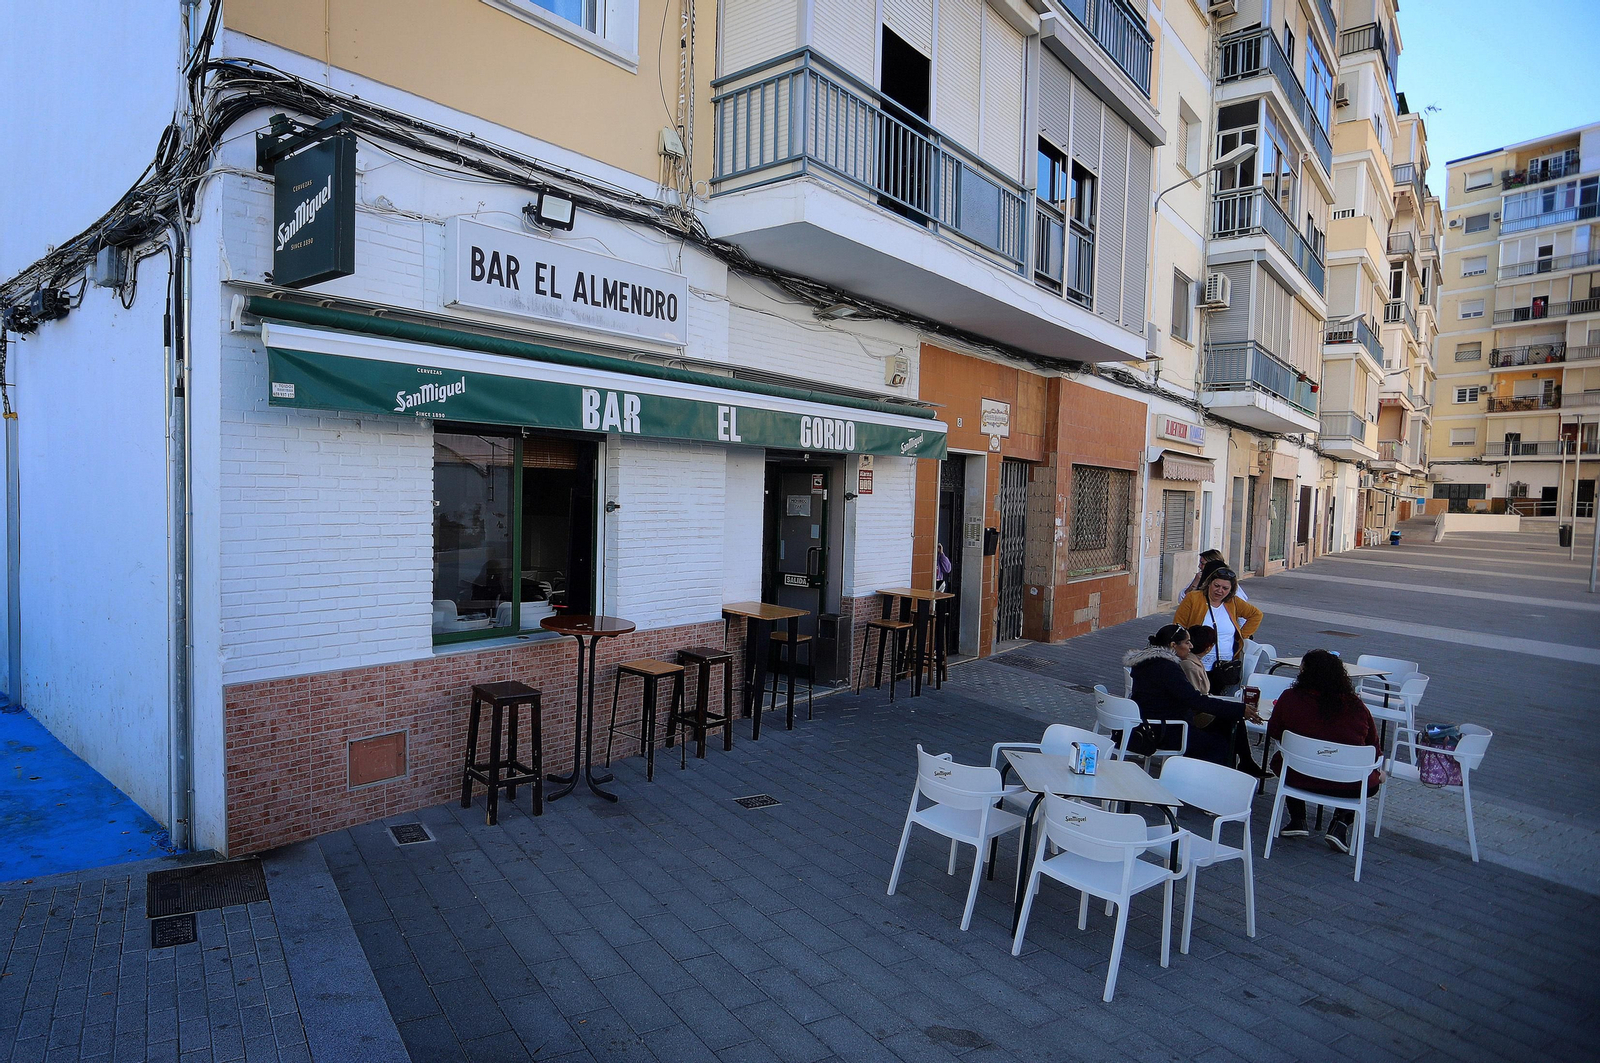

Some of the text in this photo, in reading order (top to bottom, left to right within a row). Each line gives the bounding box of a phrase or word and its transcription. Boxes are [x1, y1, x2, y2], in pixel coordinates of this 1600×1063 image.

[471, 245, 678, 323] BAR EL ALMENDRO
[416, 367, 443, 376] CERVEZAS
[582, 388, 856, 451] BAR EL GORDO
